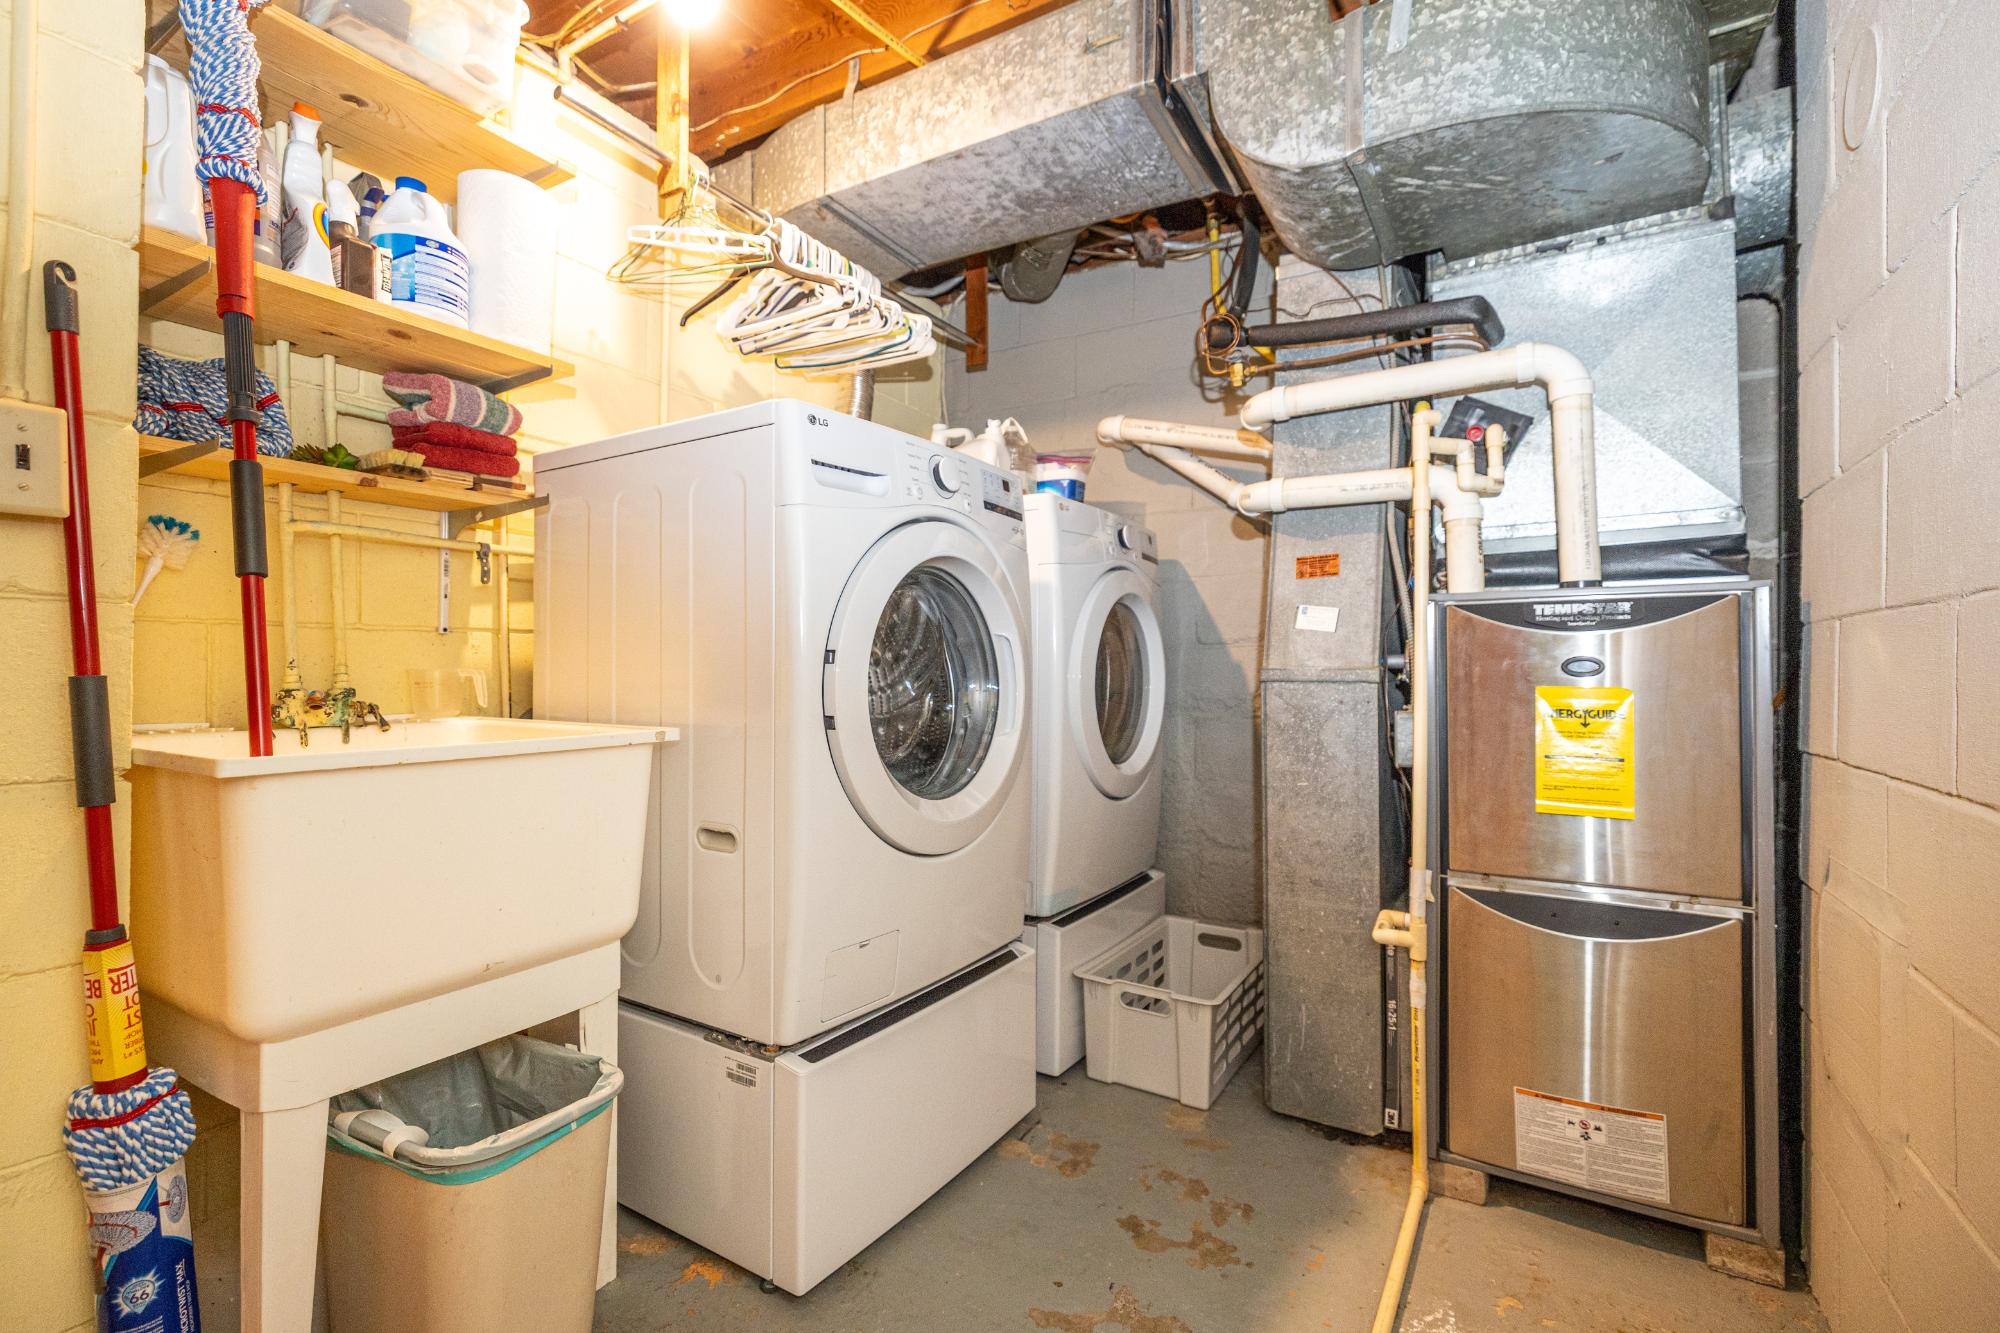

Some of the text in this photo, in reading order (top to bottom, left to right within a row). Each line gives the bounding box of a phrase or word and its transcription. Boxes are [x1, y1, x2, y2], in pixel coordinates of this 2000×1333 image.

[1533, 602, 1632, 616] TEMPSTAR
[108, 969, 138, 994] TER
[1387, 1111, 1396, 1125] 3M
[175, 1261, 189, 1333] ICROTWIST MAX
